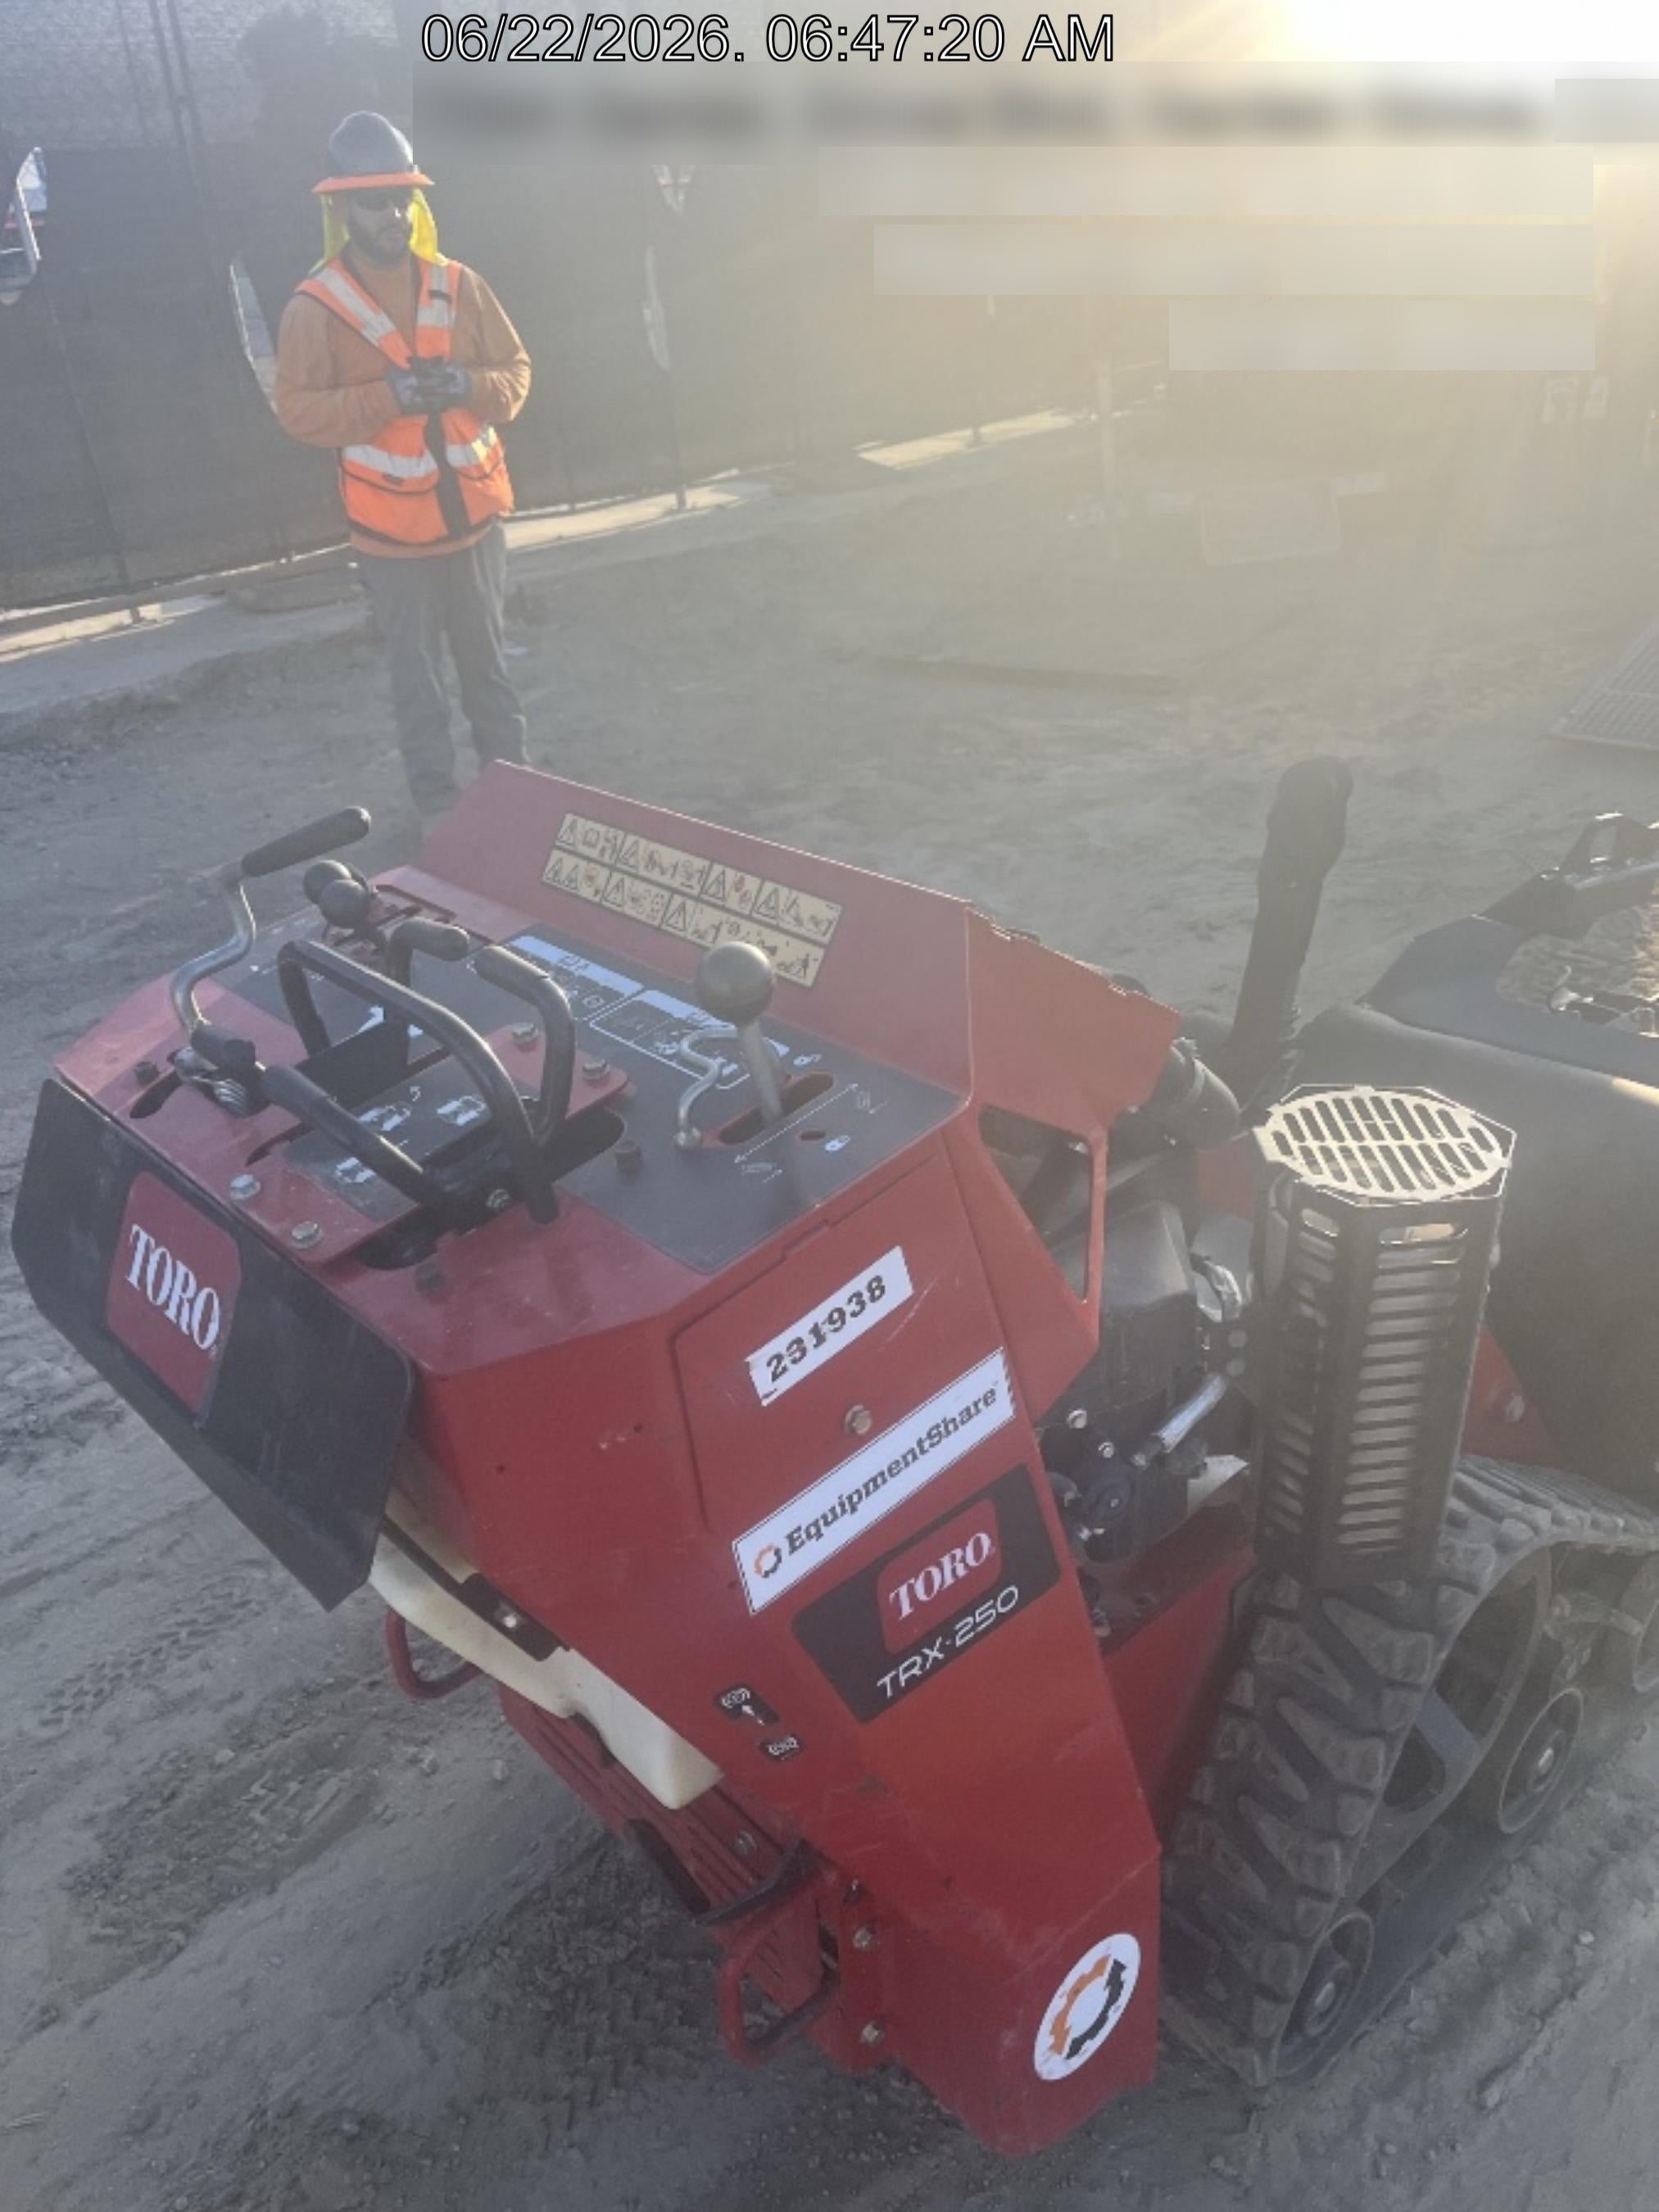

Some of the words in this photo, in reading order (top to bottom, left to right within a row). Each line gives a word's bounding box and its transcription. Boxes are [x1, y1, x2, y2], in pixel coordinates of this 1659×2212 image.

[125, 1224, 220, 1350] TORO
[766, 1275, 886, 1383] 231938
[785, 1387, 997, 1557] EquipmentShare
[889, 1532, 992, 1620] TORO
